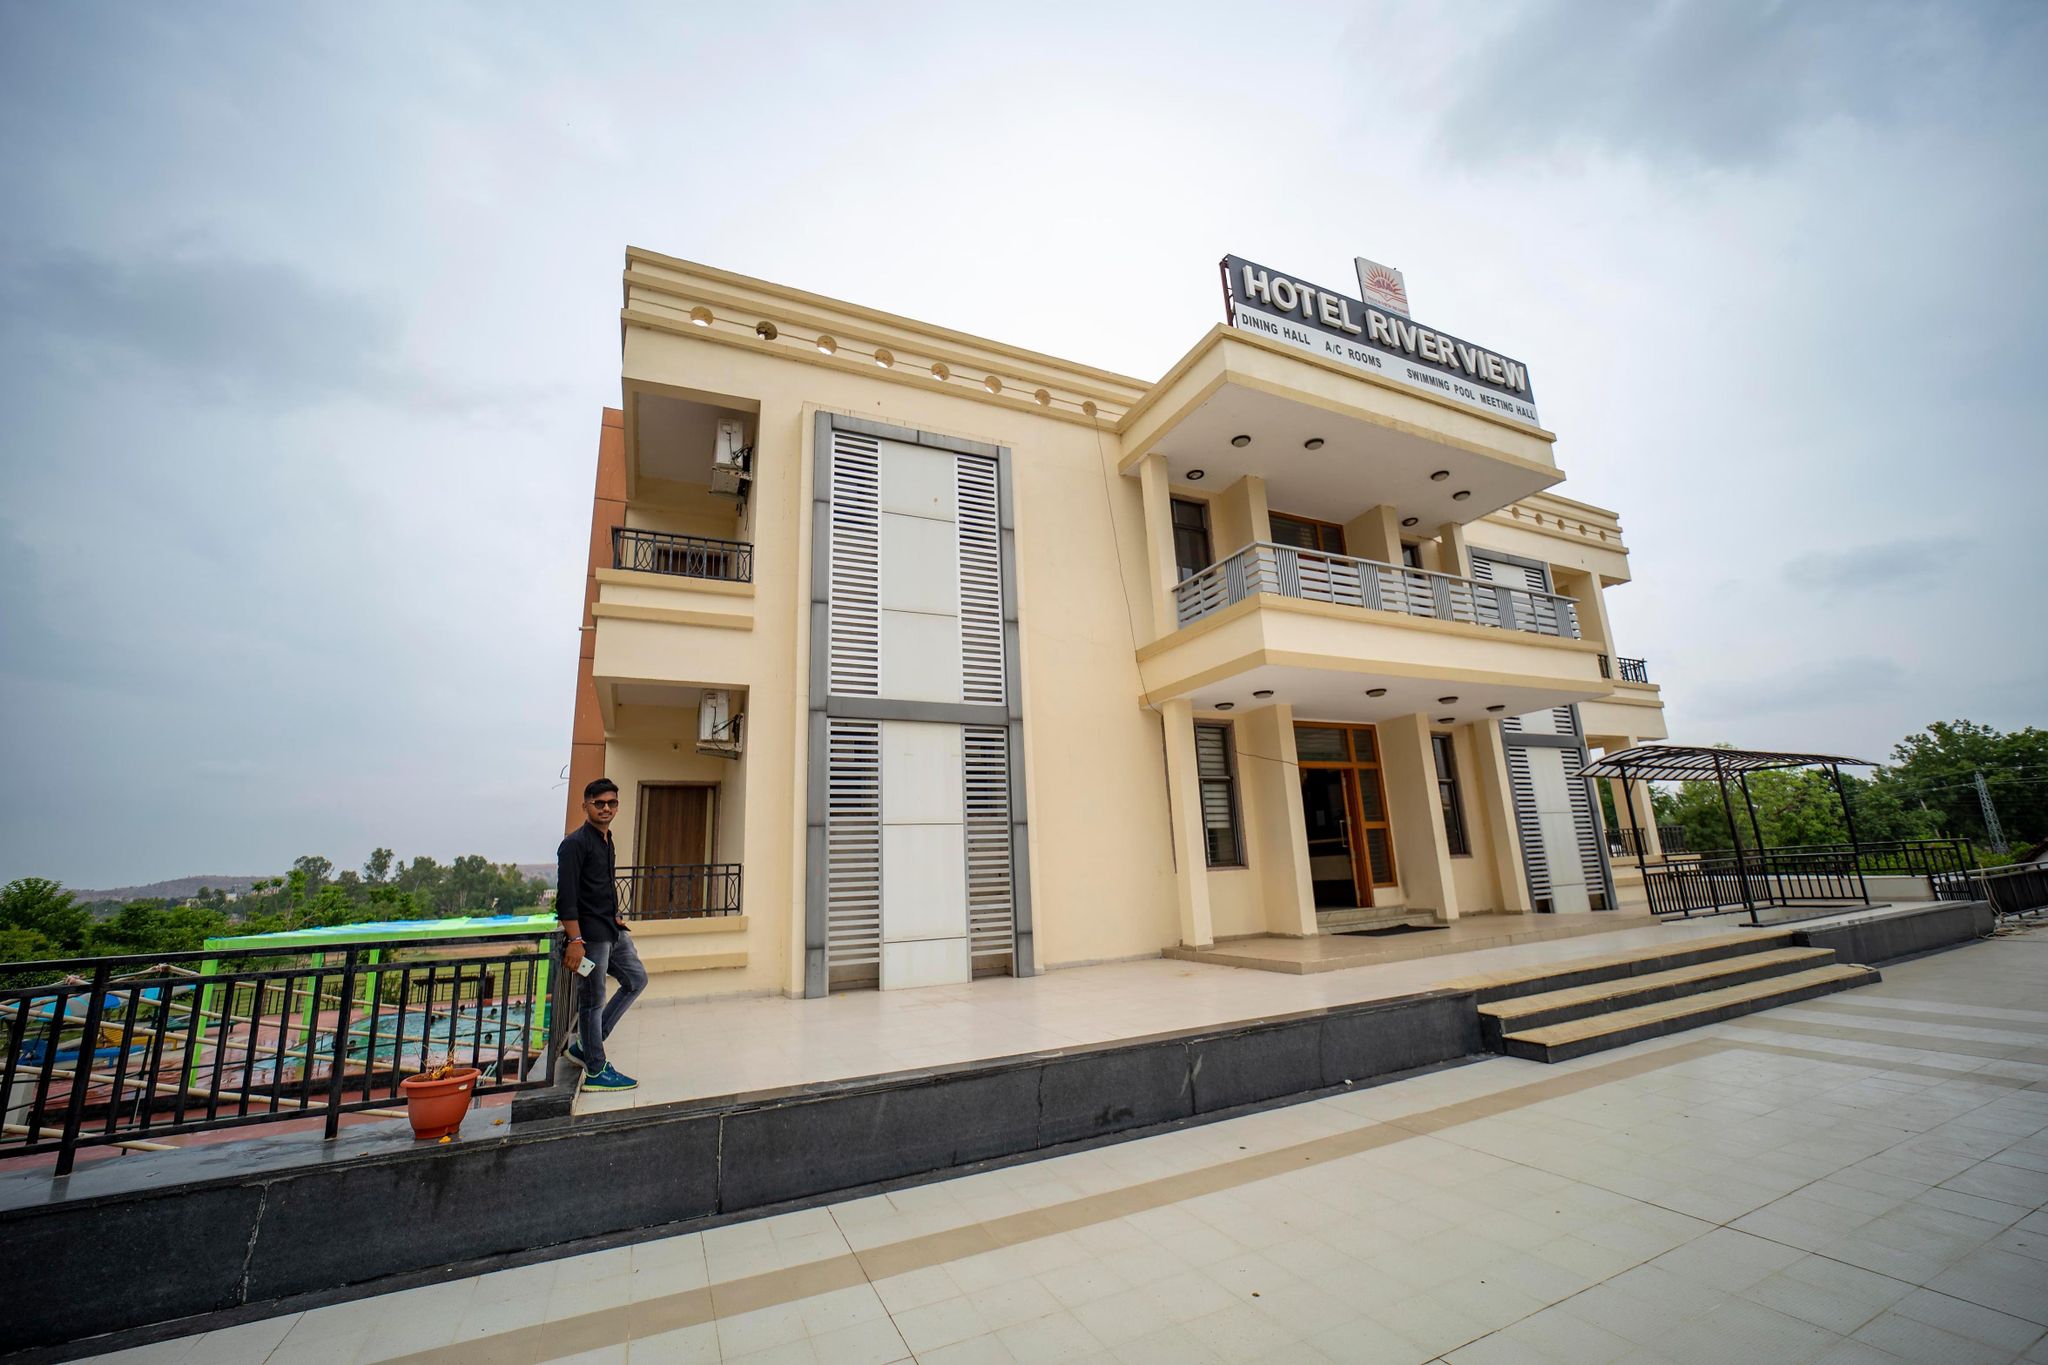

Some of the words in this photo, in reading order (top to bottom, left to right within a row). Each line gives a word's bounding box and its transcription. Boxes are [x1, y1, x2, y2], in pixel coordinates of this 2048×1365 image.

[1242, 265, 1362, 335] HOTEL
[1364, 309, 1460, 369] RIVER
[1456, 344, 1526, 392] VIEW
[1242, 313, 1278, 335] DINING
[1282, 326, 1311, 346] HALL
[1325, 341, 1342, 355] A/C
[1348, 348, 1382, 368] ROOMS
[1407, 368, 1450, 391] SWIMMING
[1454, 384, 1475, 400] POOL
[1480, 393, 1514, 413] MEETING
[1516, 406, 1535, 420] HALL
